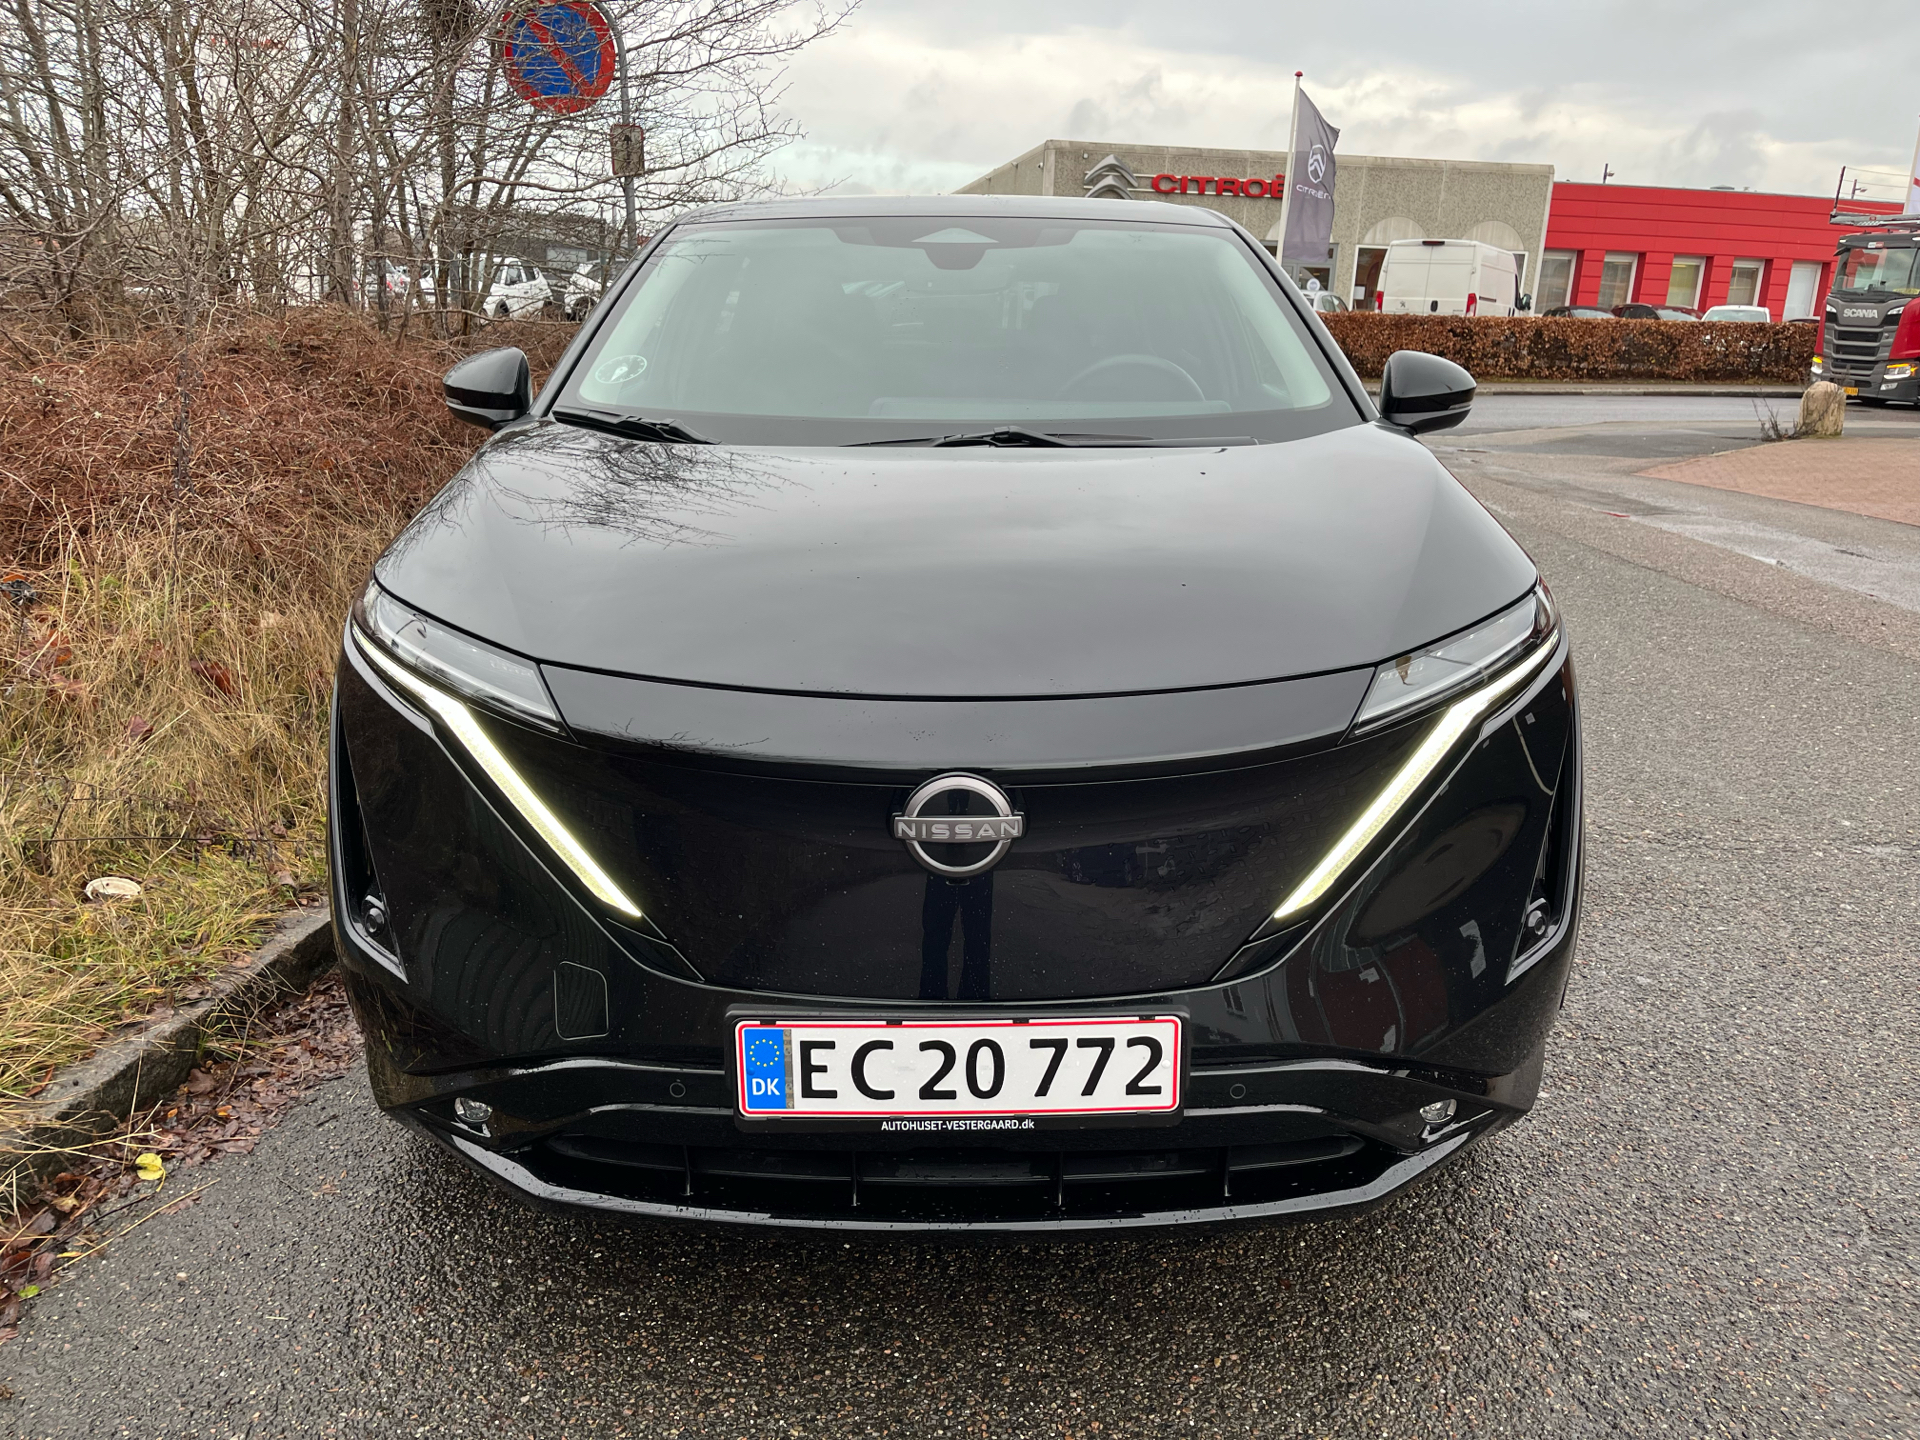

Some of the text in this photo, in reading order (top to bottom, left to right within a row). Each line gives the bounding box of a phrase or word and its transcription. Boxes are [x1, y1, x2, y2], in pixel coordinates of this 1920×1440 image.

[1151, 173, 1285, 198] CITROË
[1843, 308, 1878, 319] SCANIA
[897, 820, 1019, 839] NISSAN
[799, 1036, 1163, 1101] EC 20 772
[752, 1078, 780, 1096] DK
[881, 1119, 1035, 1131] AUTOHUSET-VESTERGAARD.dk
